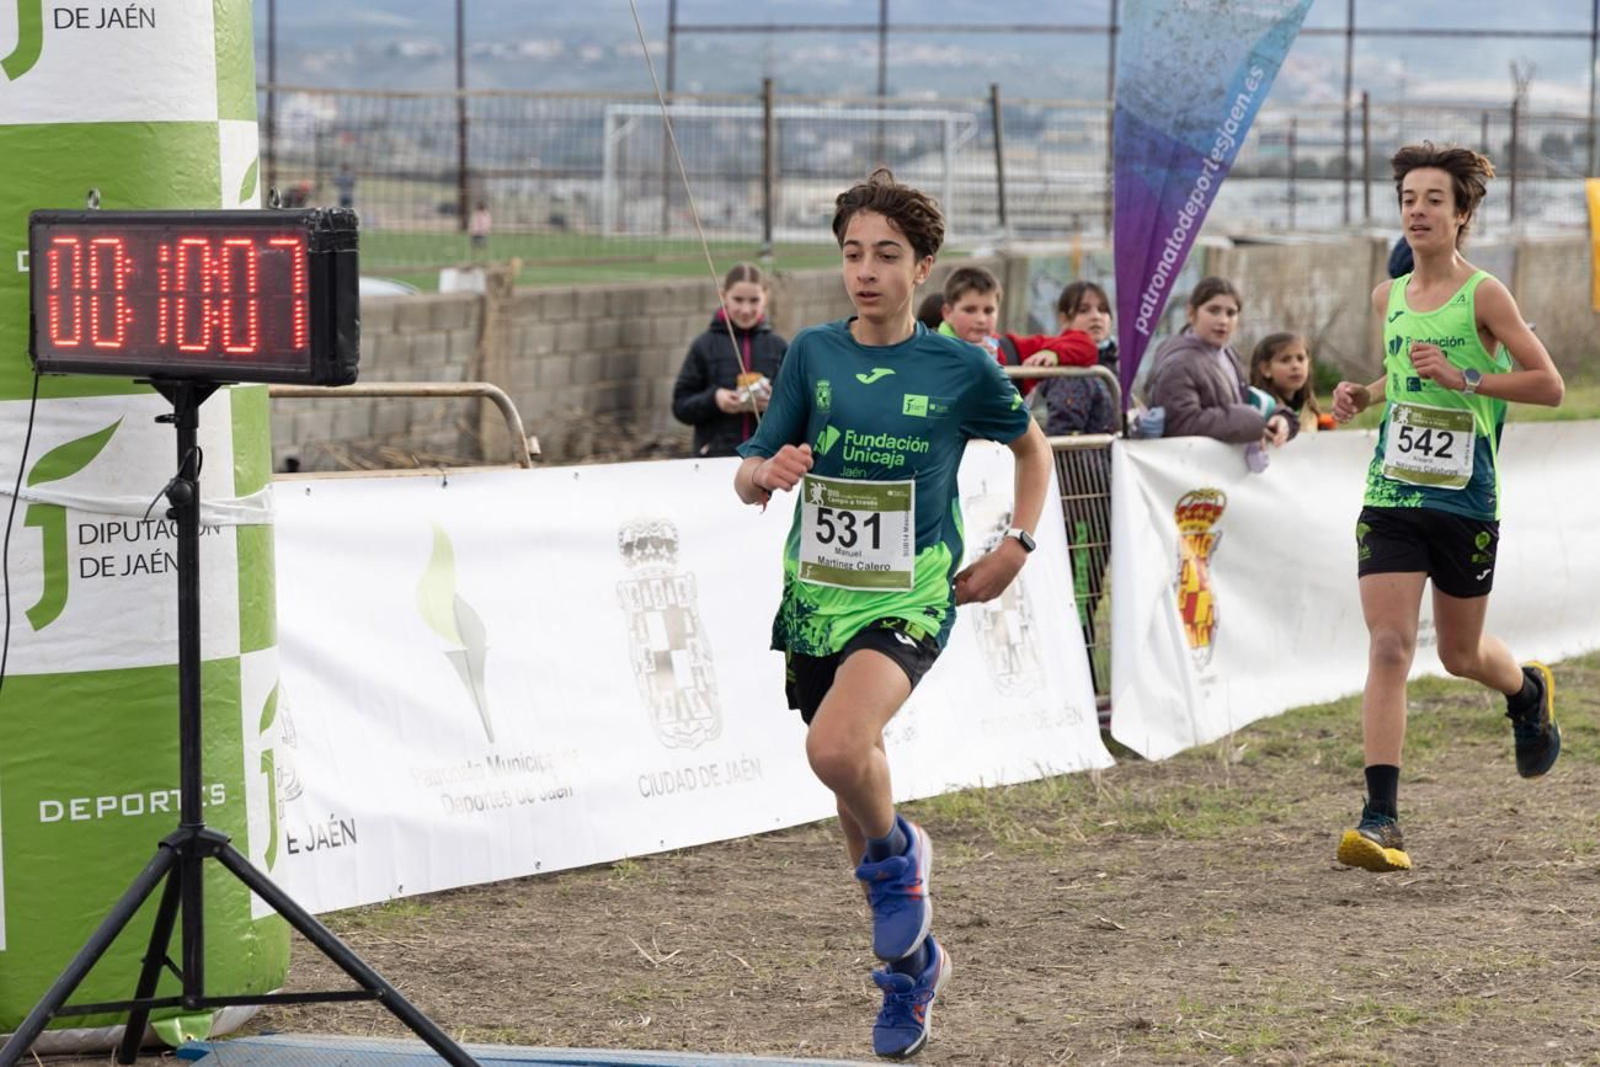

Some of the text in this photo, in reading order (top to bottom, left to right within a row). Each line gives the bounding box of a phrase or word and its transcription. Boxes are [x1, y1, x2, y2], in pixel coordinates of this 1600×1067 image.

[54, 3, 156, 29] DE JAÉN
[1134, 64, 1264, 336] patronatodeportesjaen.es
[844, 429, 930, 454] Fundación
[1397, 425, 1454, 459] 542
[842, 446, 906, 470] Unicaja
[815, 506, 881, 549] 531
[80, 548, 179, 579] DE JAÉN
[834, 546, 863, 558] Manuel
[856, 561, 891, 572] Calero
[638, 768, 698, 798] CIUDAD
[698, 763, 721, 789] DE
[39, 783, 226, 823] DEPORTS
[305, 812, 357, 852] JAÉN
